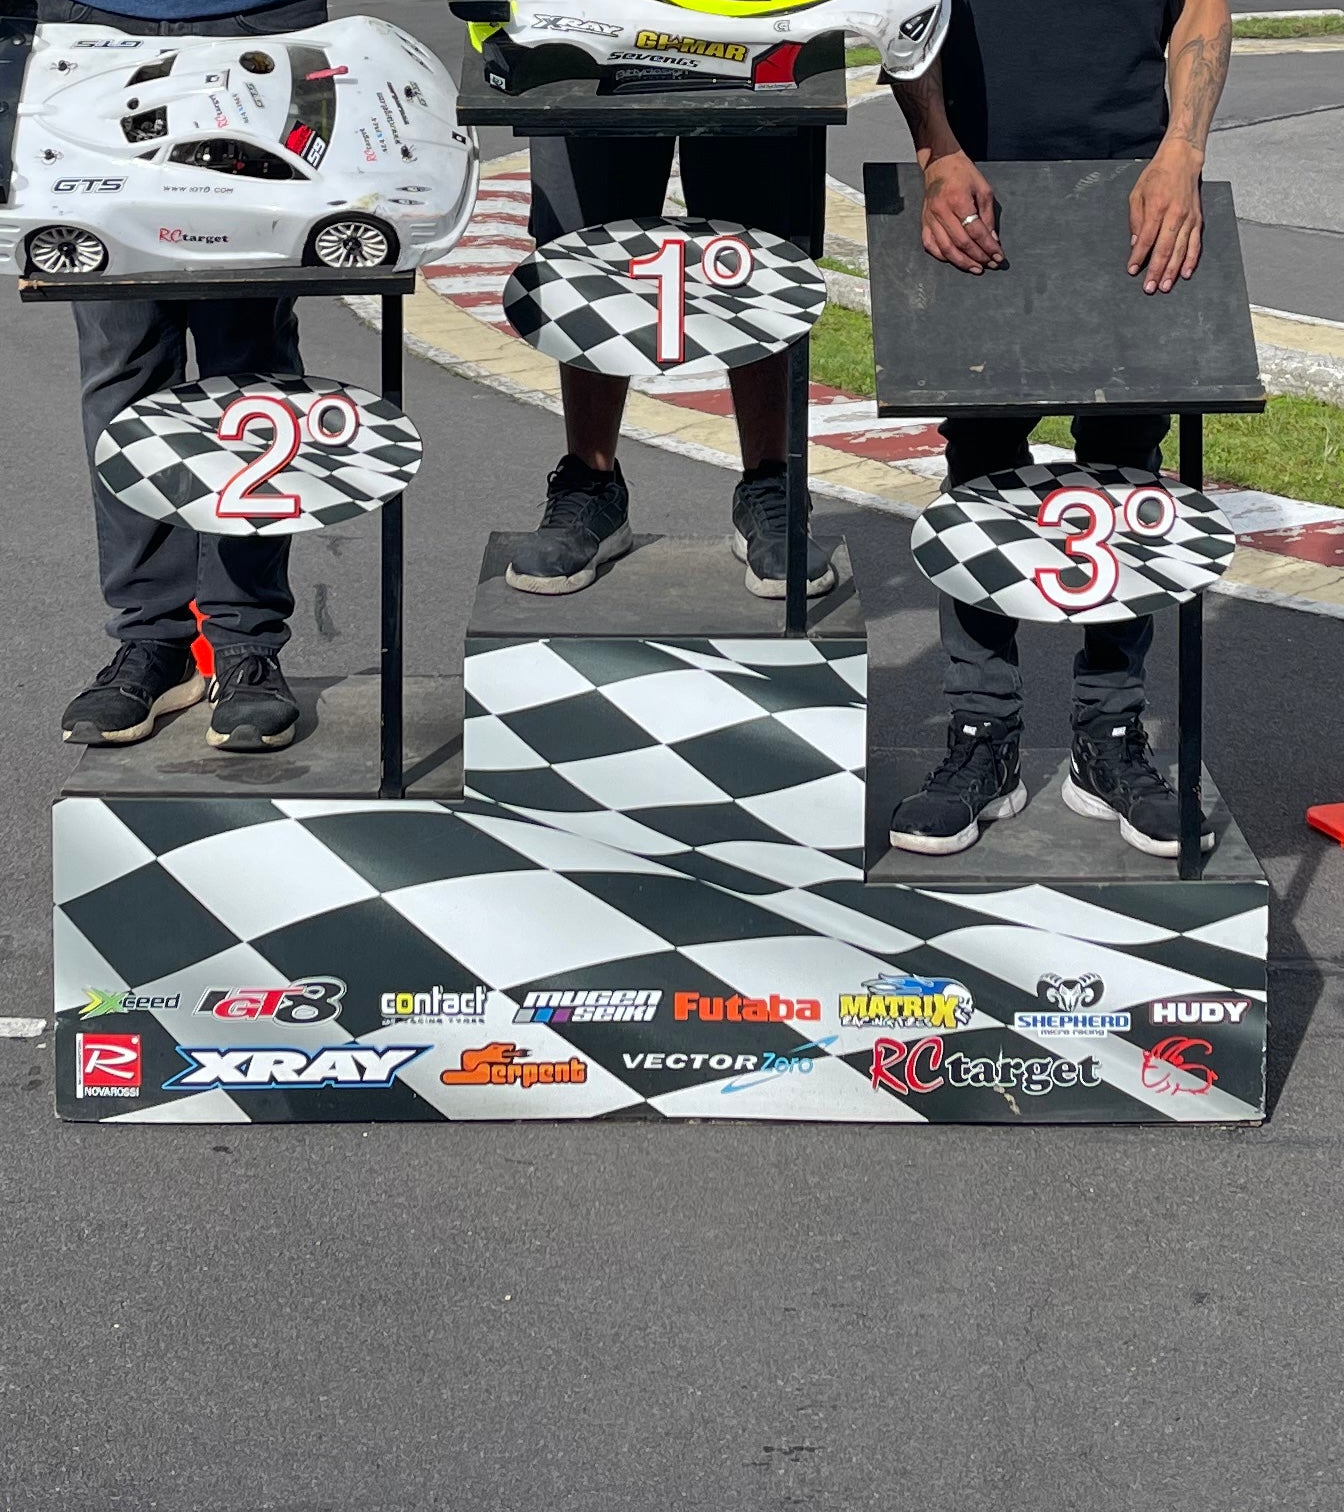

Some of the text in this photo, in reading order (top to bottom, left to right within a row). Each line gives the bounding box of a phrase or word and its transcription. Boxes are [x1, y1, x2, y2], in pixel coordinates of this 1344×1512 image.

[532, 13, 624, 37] XRAY
[51, 176, 128, 193] GTS
[381, 984, 488, 1015] contact
[673, 991, 821, 1022] Futaba
[840, 993, 958, 1028] MATRIX
[1017, 1014, 1129, 1028] SHEPHERD
[1153, 1001, 1247, 1023] HUDY
[174, 1045, 426, 1087] XRAY
[441, 1042, 588, 1088] Serpent
[622, 1052, 758, 1071] VECTOR
[84, 1086, 140, 1097] NOVAROSSI
